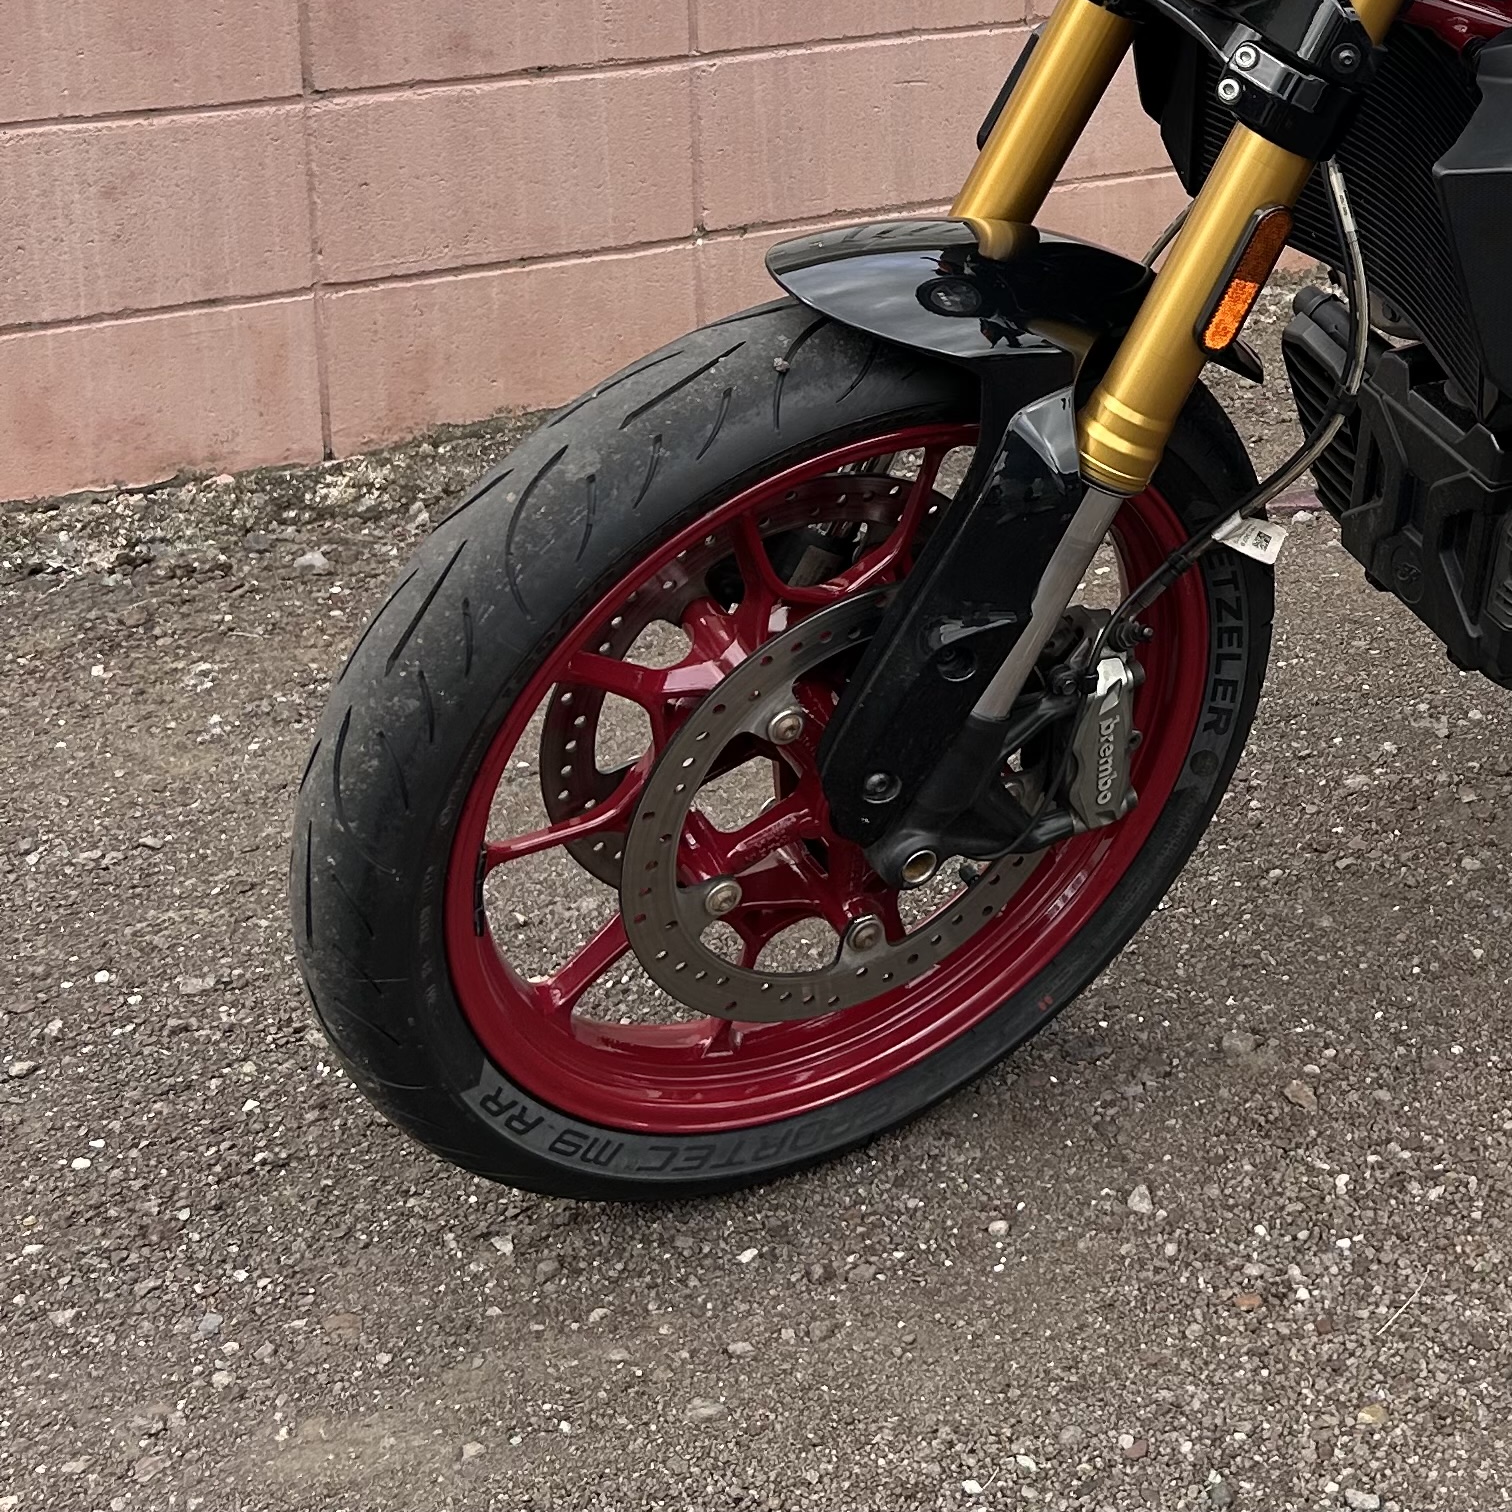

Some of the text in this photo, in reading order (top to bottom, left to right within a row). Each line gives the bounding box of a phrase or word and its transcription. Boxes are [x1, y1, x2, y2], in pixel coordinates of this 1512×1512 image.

[1203, 550, 1243, 736] ETZELER
[1097, 714, 1120, 805] brembo
[478, 1085, 544, 1137] RR
